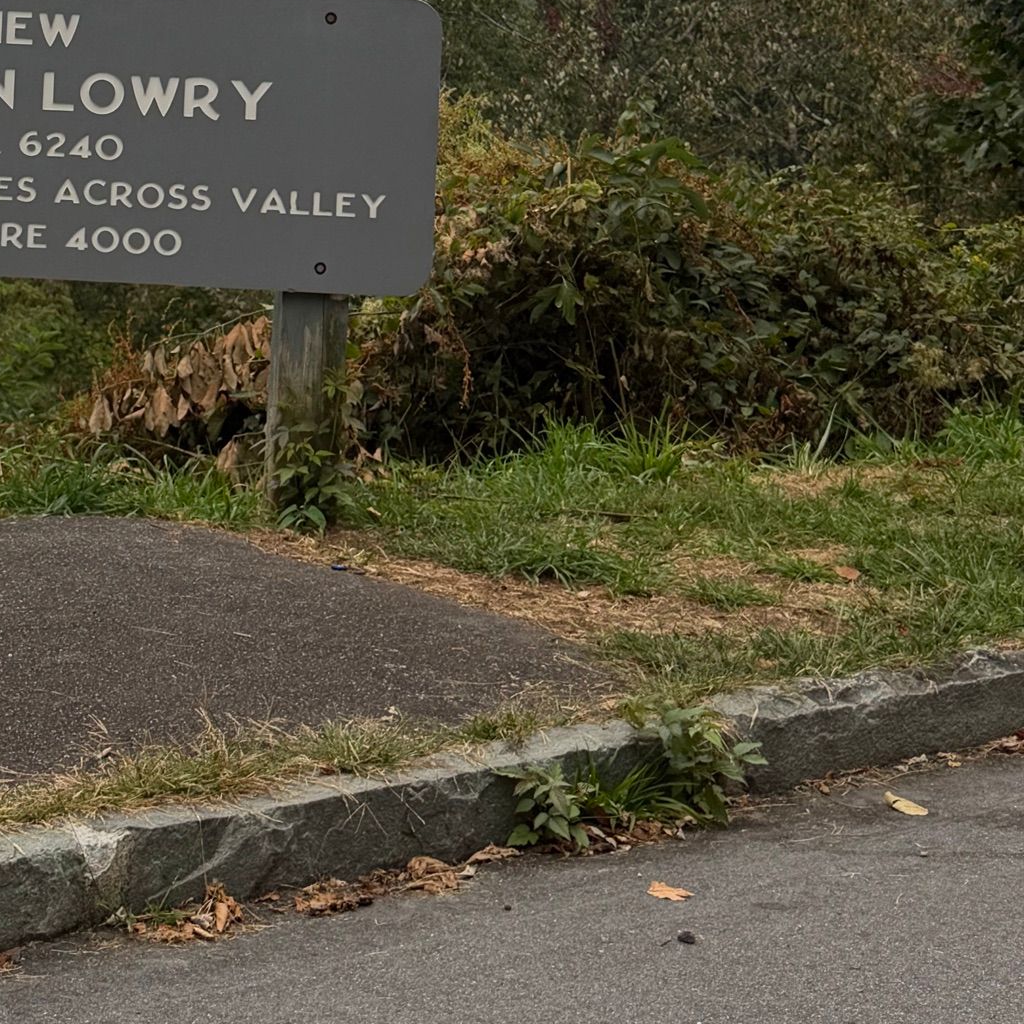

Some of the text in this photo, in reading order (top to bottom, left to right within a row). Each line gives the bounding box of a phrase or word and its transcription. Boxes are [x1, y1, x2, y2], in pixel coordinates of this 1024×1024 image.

[43, 72, 272, 120] LOWRY
[19, 131, 123, 160] 6240
[54, 179, 211, 210] ACROSS
[232, 188, 385, 218] VALLEY
[66, 227, 181, 255] 4000
